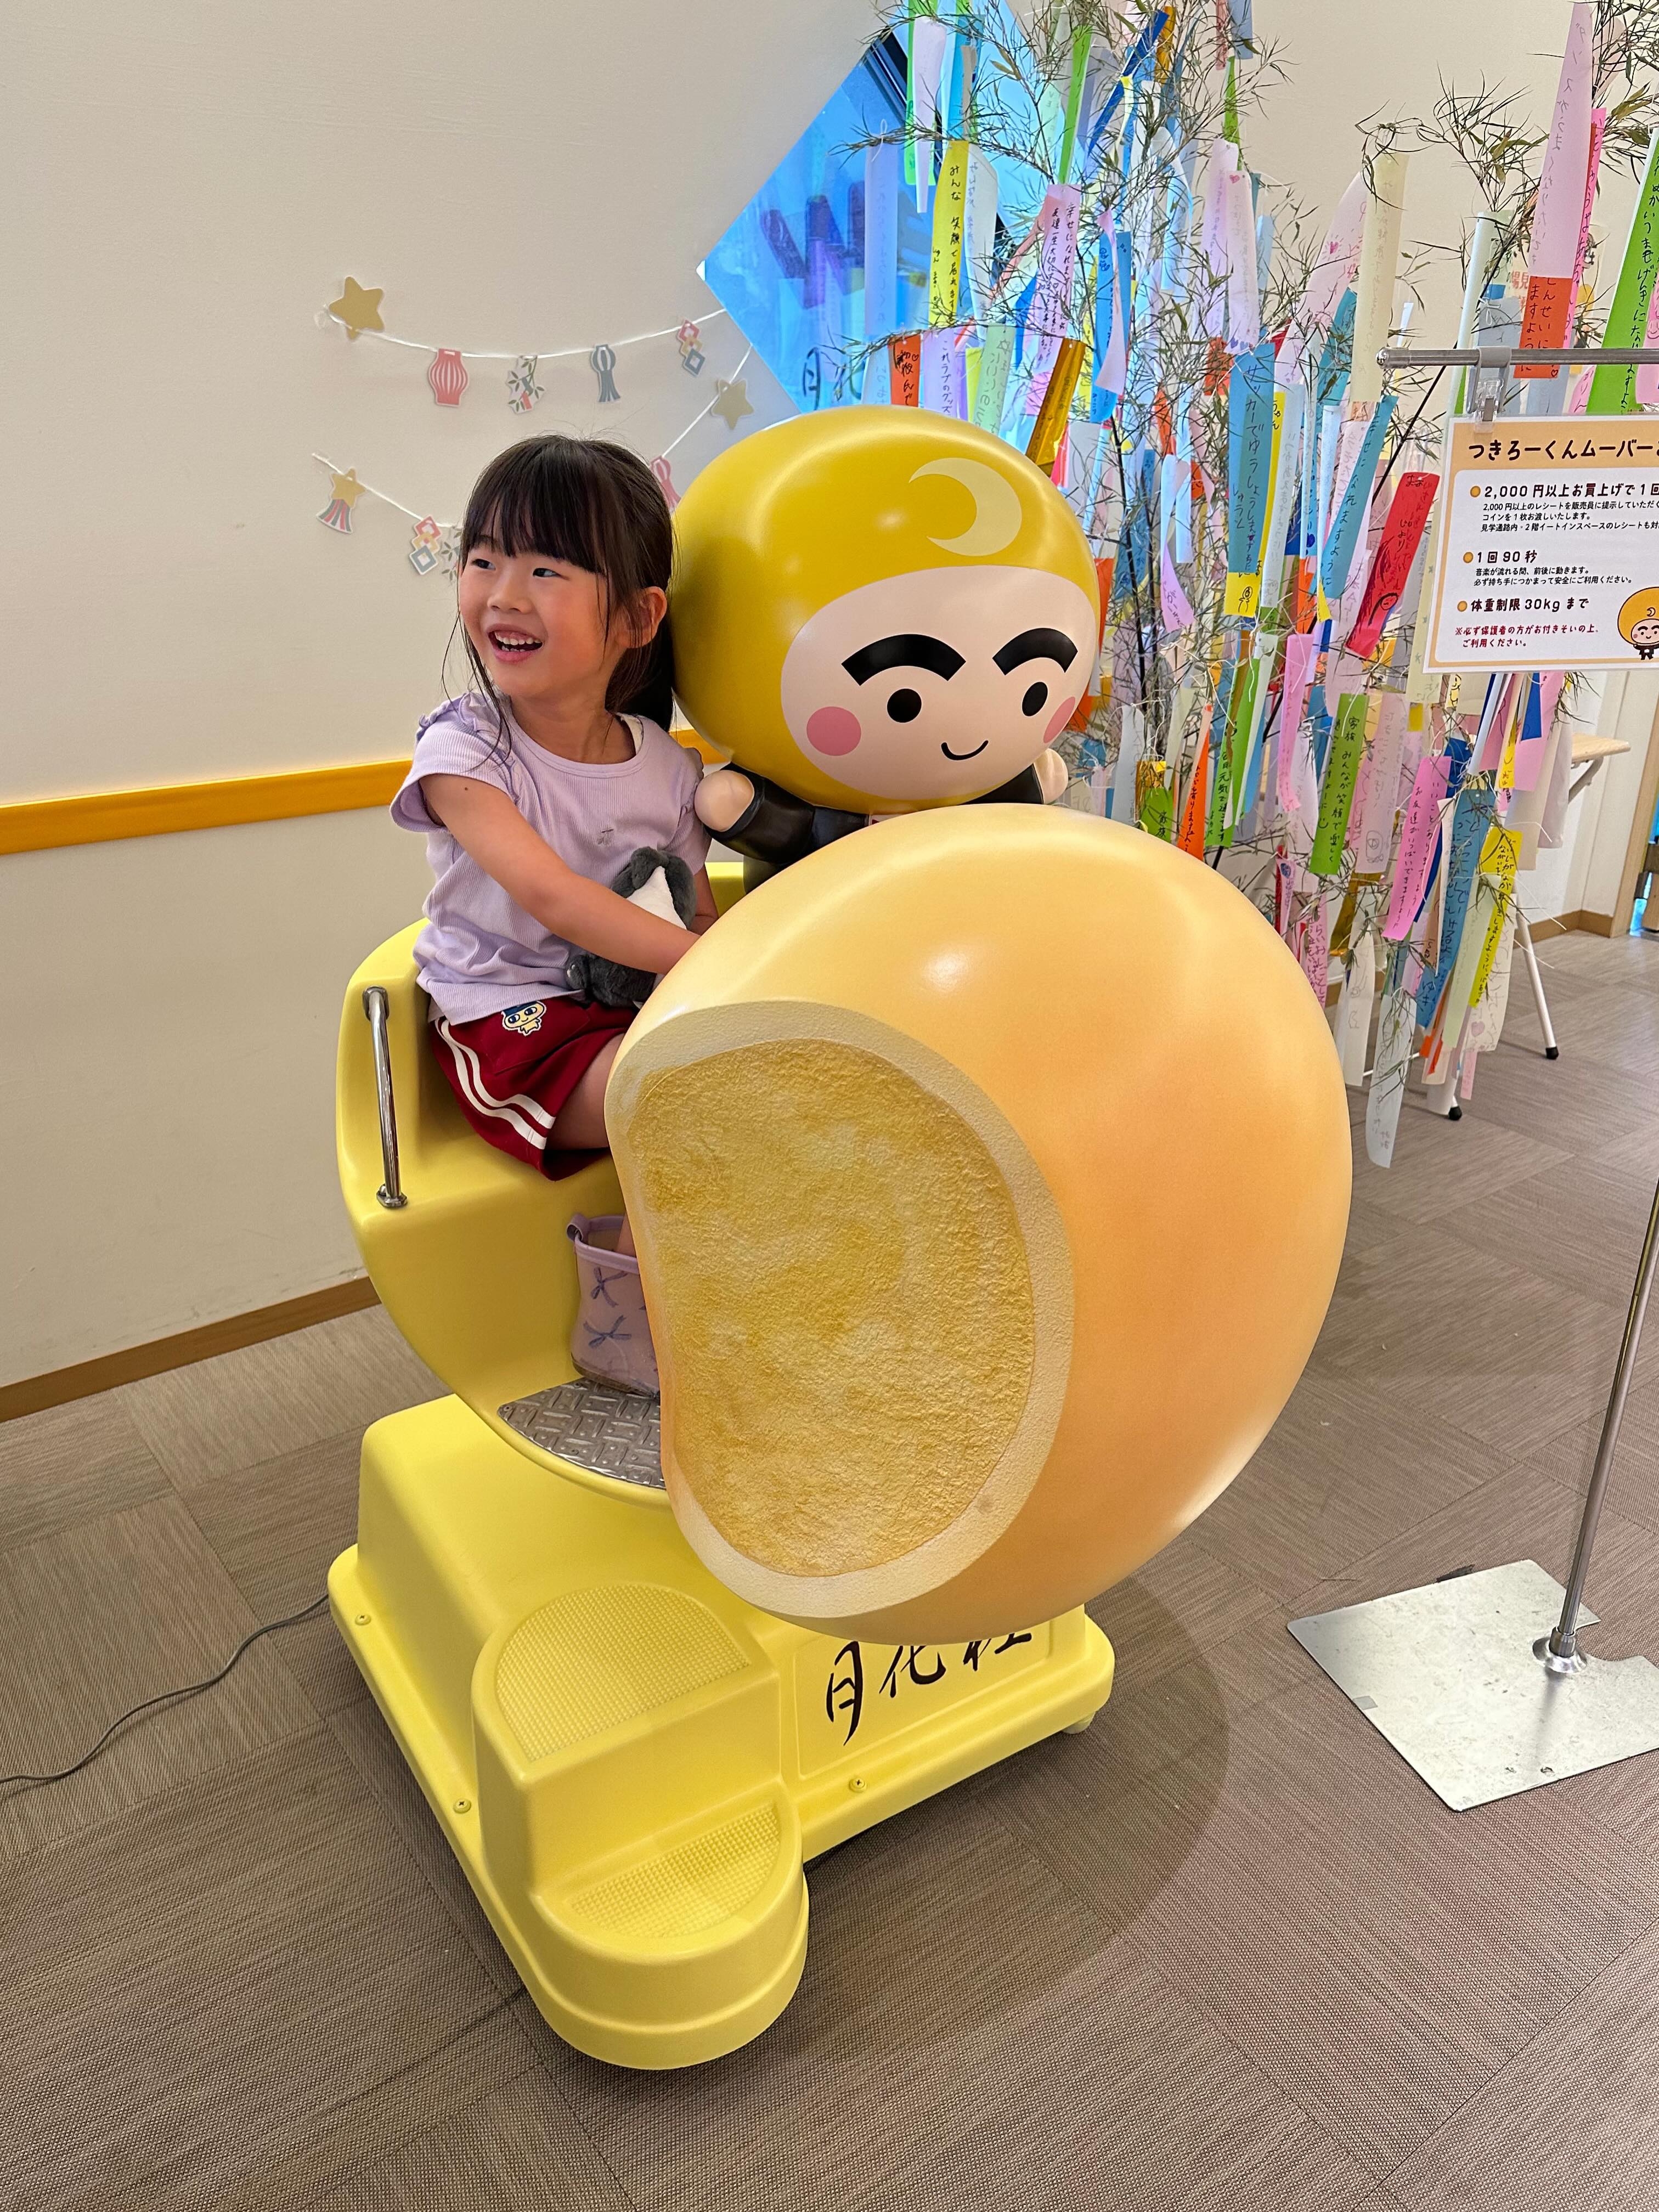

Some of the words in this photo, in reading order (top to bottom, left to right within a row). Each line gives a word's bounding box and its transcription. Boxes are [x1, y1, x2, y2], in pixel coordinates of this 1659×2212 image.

[1469, 439, 1659, 460] つきろーくんムーバー
[1463, 638, 1527, 648] ご利用ください。
